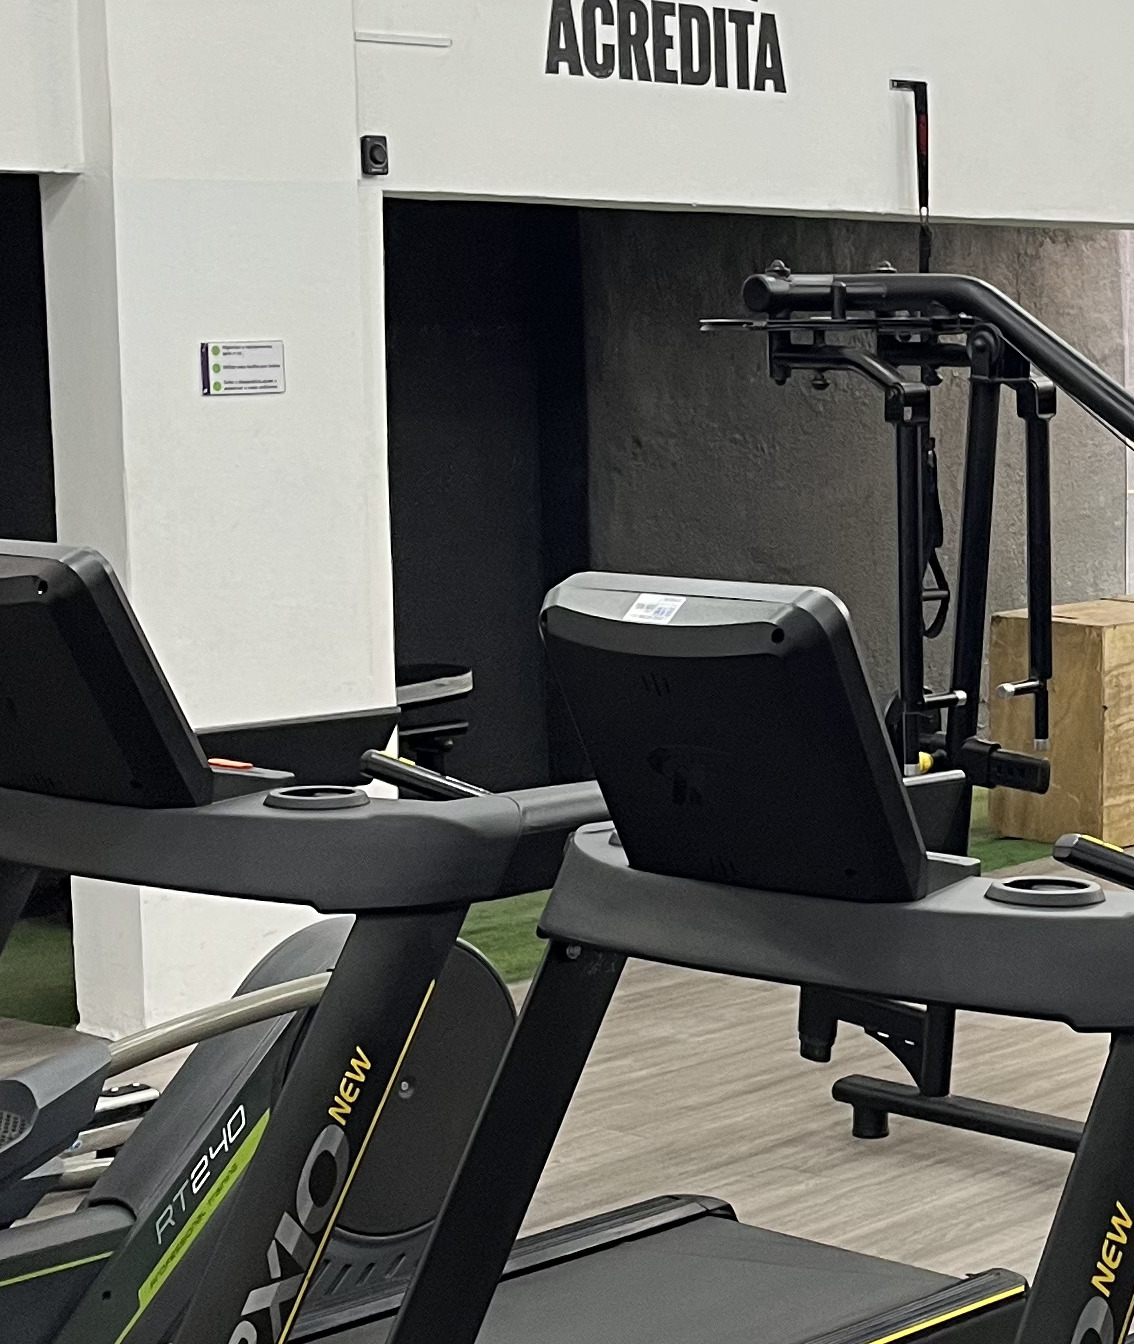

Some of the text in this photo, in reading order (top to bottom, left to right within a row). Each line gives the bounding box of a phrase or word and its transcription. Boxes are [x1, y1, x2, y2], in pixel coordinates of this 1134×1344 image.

[328, 1045, 372, 1126] NEW
[155, 1104, 246, 1245] RT240
[1091, 1200, 1133, 1298] NEW
